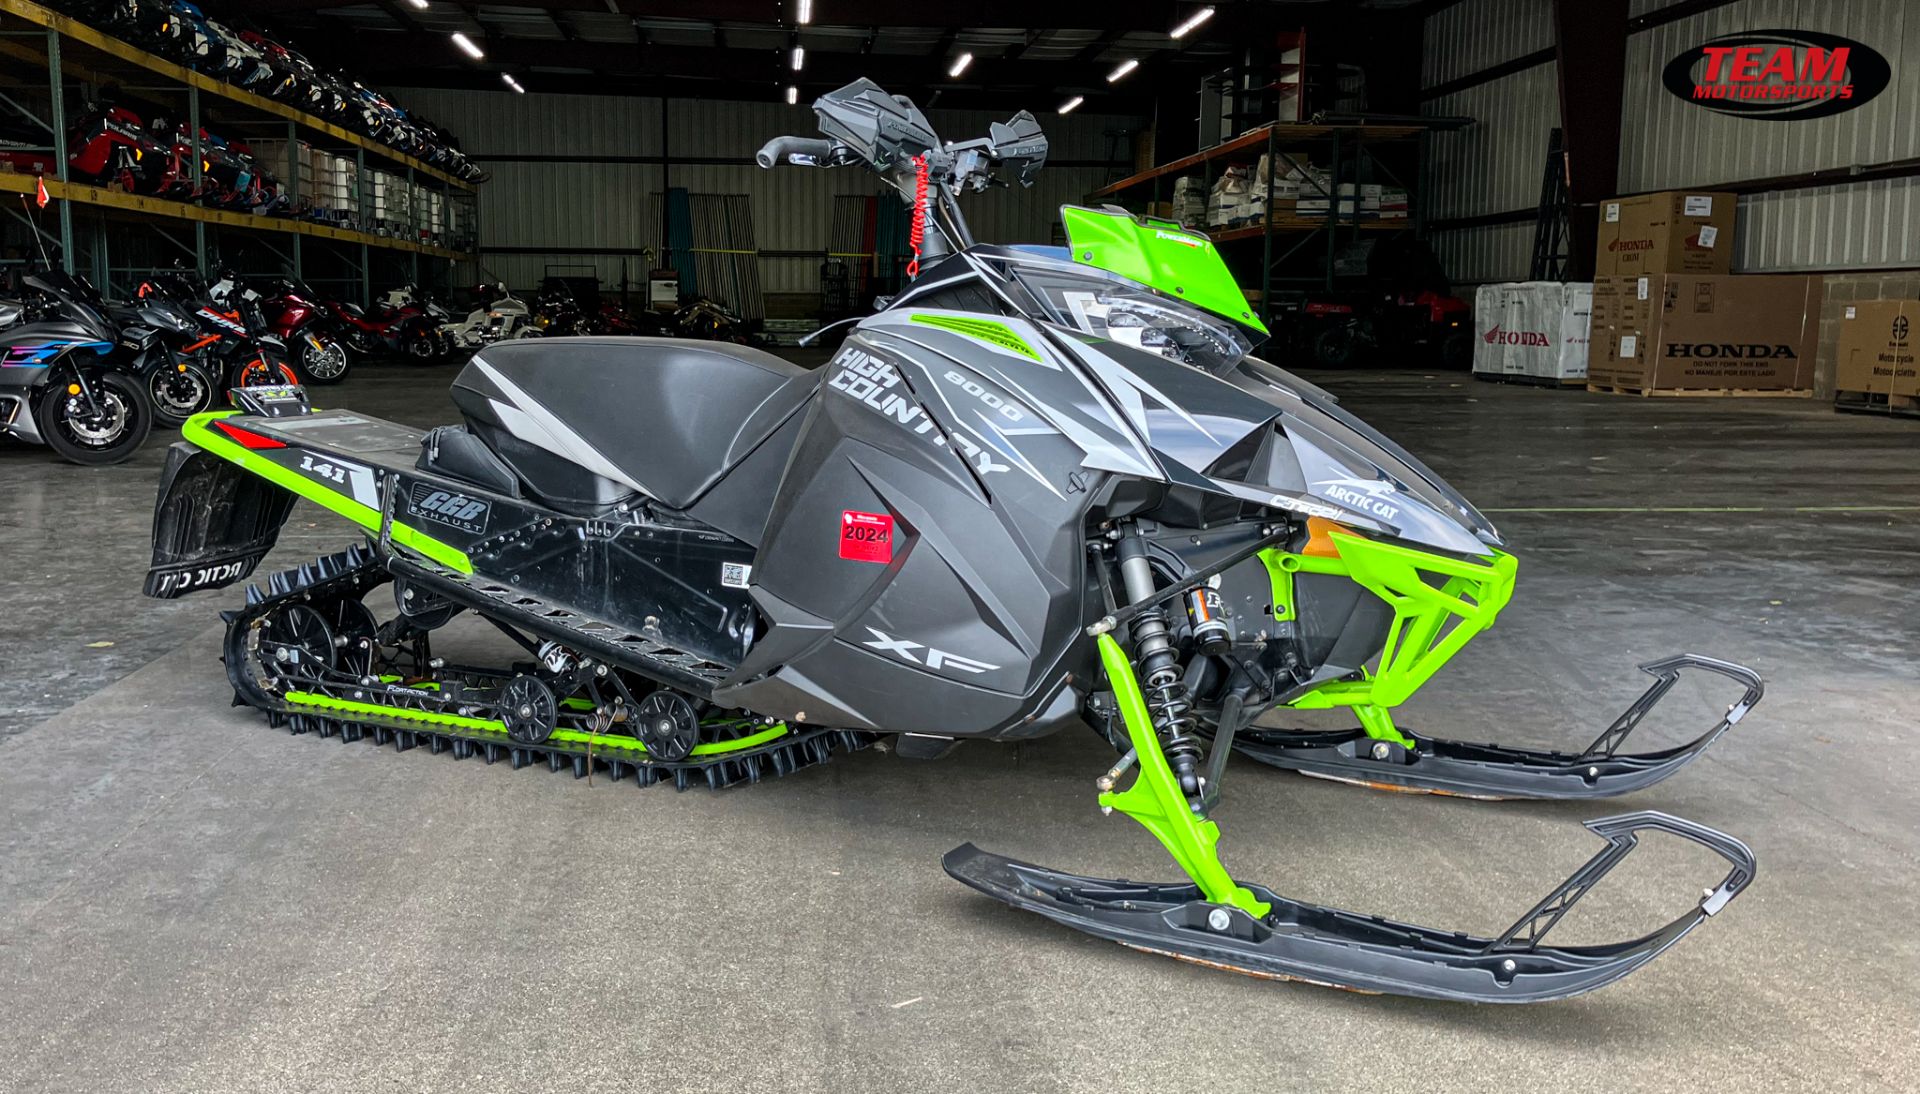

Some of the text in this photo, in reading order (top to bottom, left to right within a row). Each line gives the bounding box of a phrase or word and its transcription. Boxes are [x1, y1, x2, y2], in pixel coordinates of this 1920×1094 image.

[1619, 240, 1654, 251] HONDA
[1498, 331, 1550, 347] HONDA
[1665, 343, 1797, 358] HONDA
[834, 347, 901, 388] HIGH
[944, 371, 1024, 422] 8000
[829, 369, 1011, 475] COUNTRY
[300, 456, 346, 484] 141
[1325, 484, 1399, 520] ARCTIC CAT
[410, 506, 482, 532] EXHAUST
[845, 525, 889, 543] 2024
[862, 625, 1002, 673] XF
